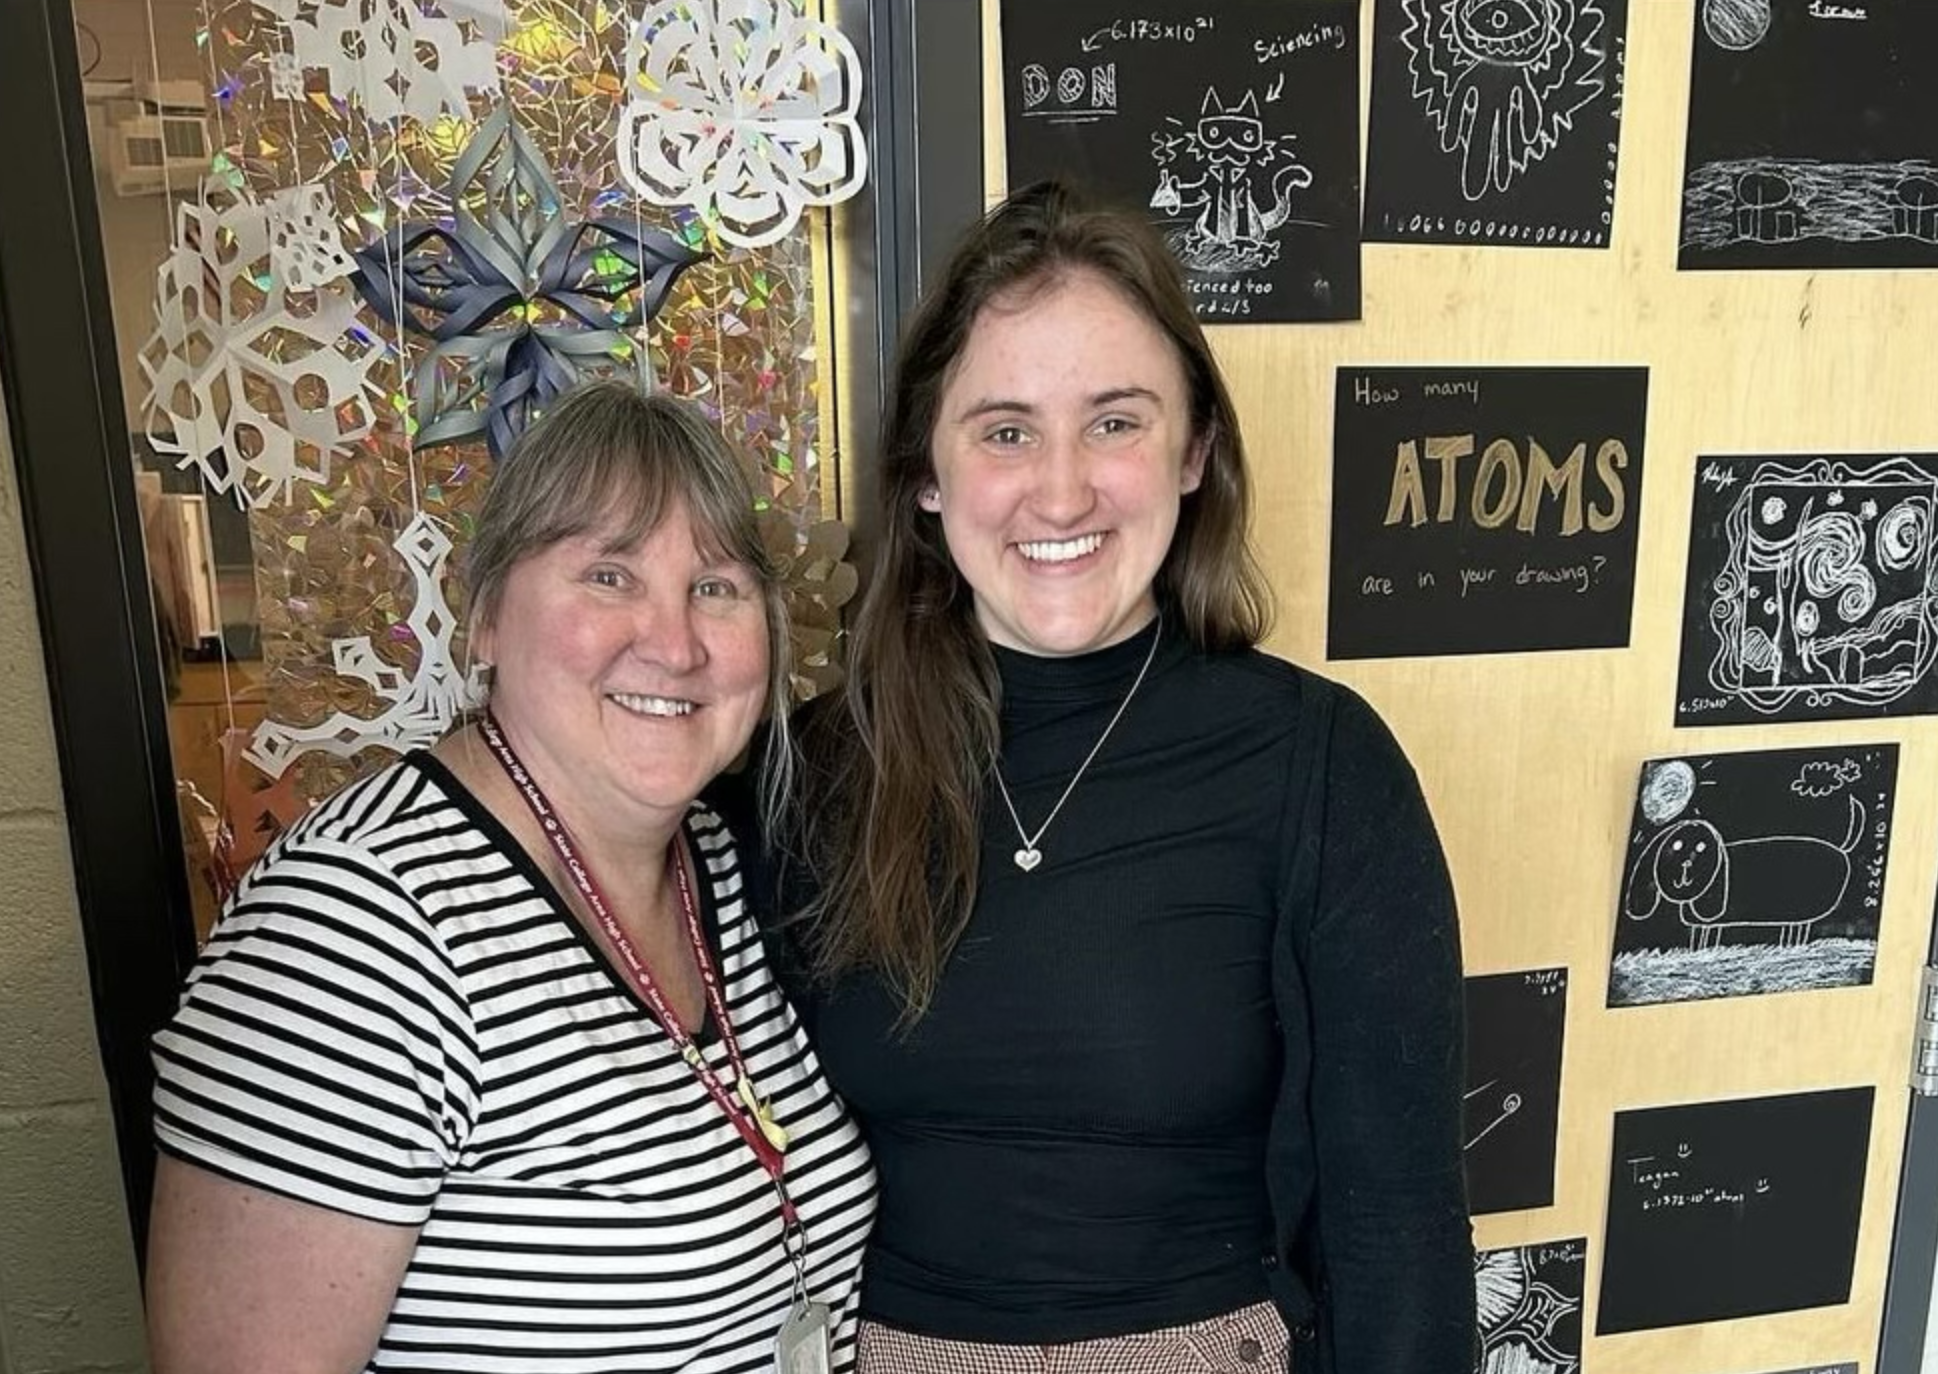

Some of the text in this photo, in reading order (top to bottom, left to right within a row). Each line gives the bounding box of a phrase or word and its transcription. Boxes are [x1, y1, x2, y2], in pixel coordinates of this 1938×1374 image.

[1253, 23, 1346, 63] Sciencing
[1021, 62, 1117, 108] DON
[1244, 277, 1273, 295] too
[1355, 377, 1479, 405] How many
[1383, 433, 1628, 537] ATOMS
[1362, 555, 1607, 598] are in your drawing?
[1627, 1155, 1679, 1190] Teagan
